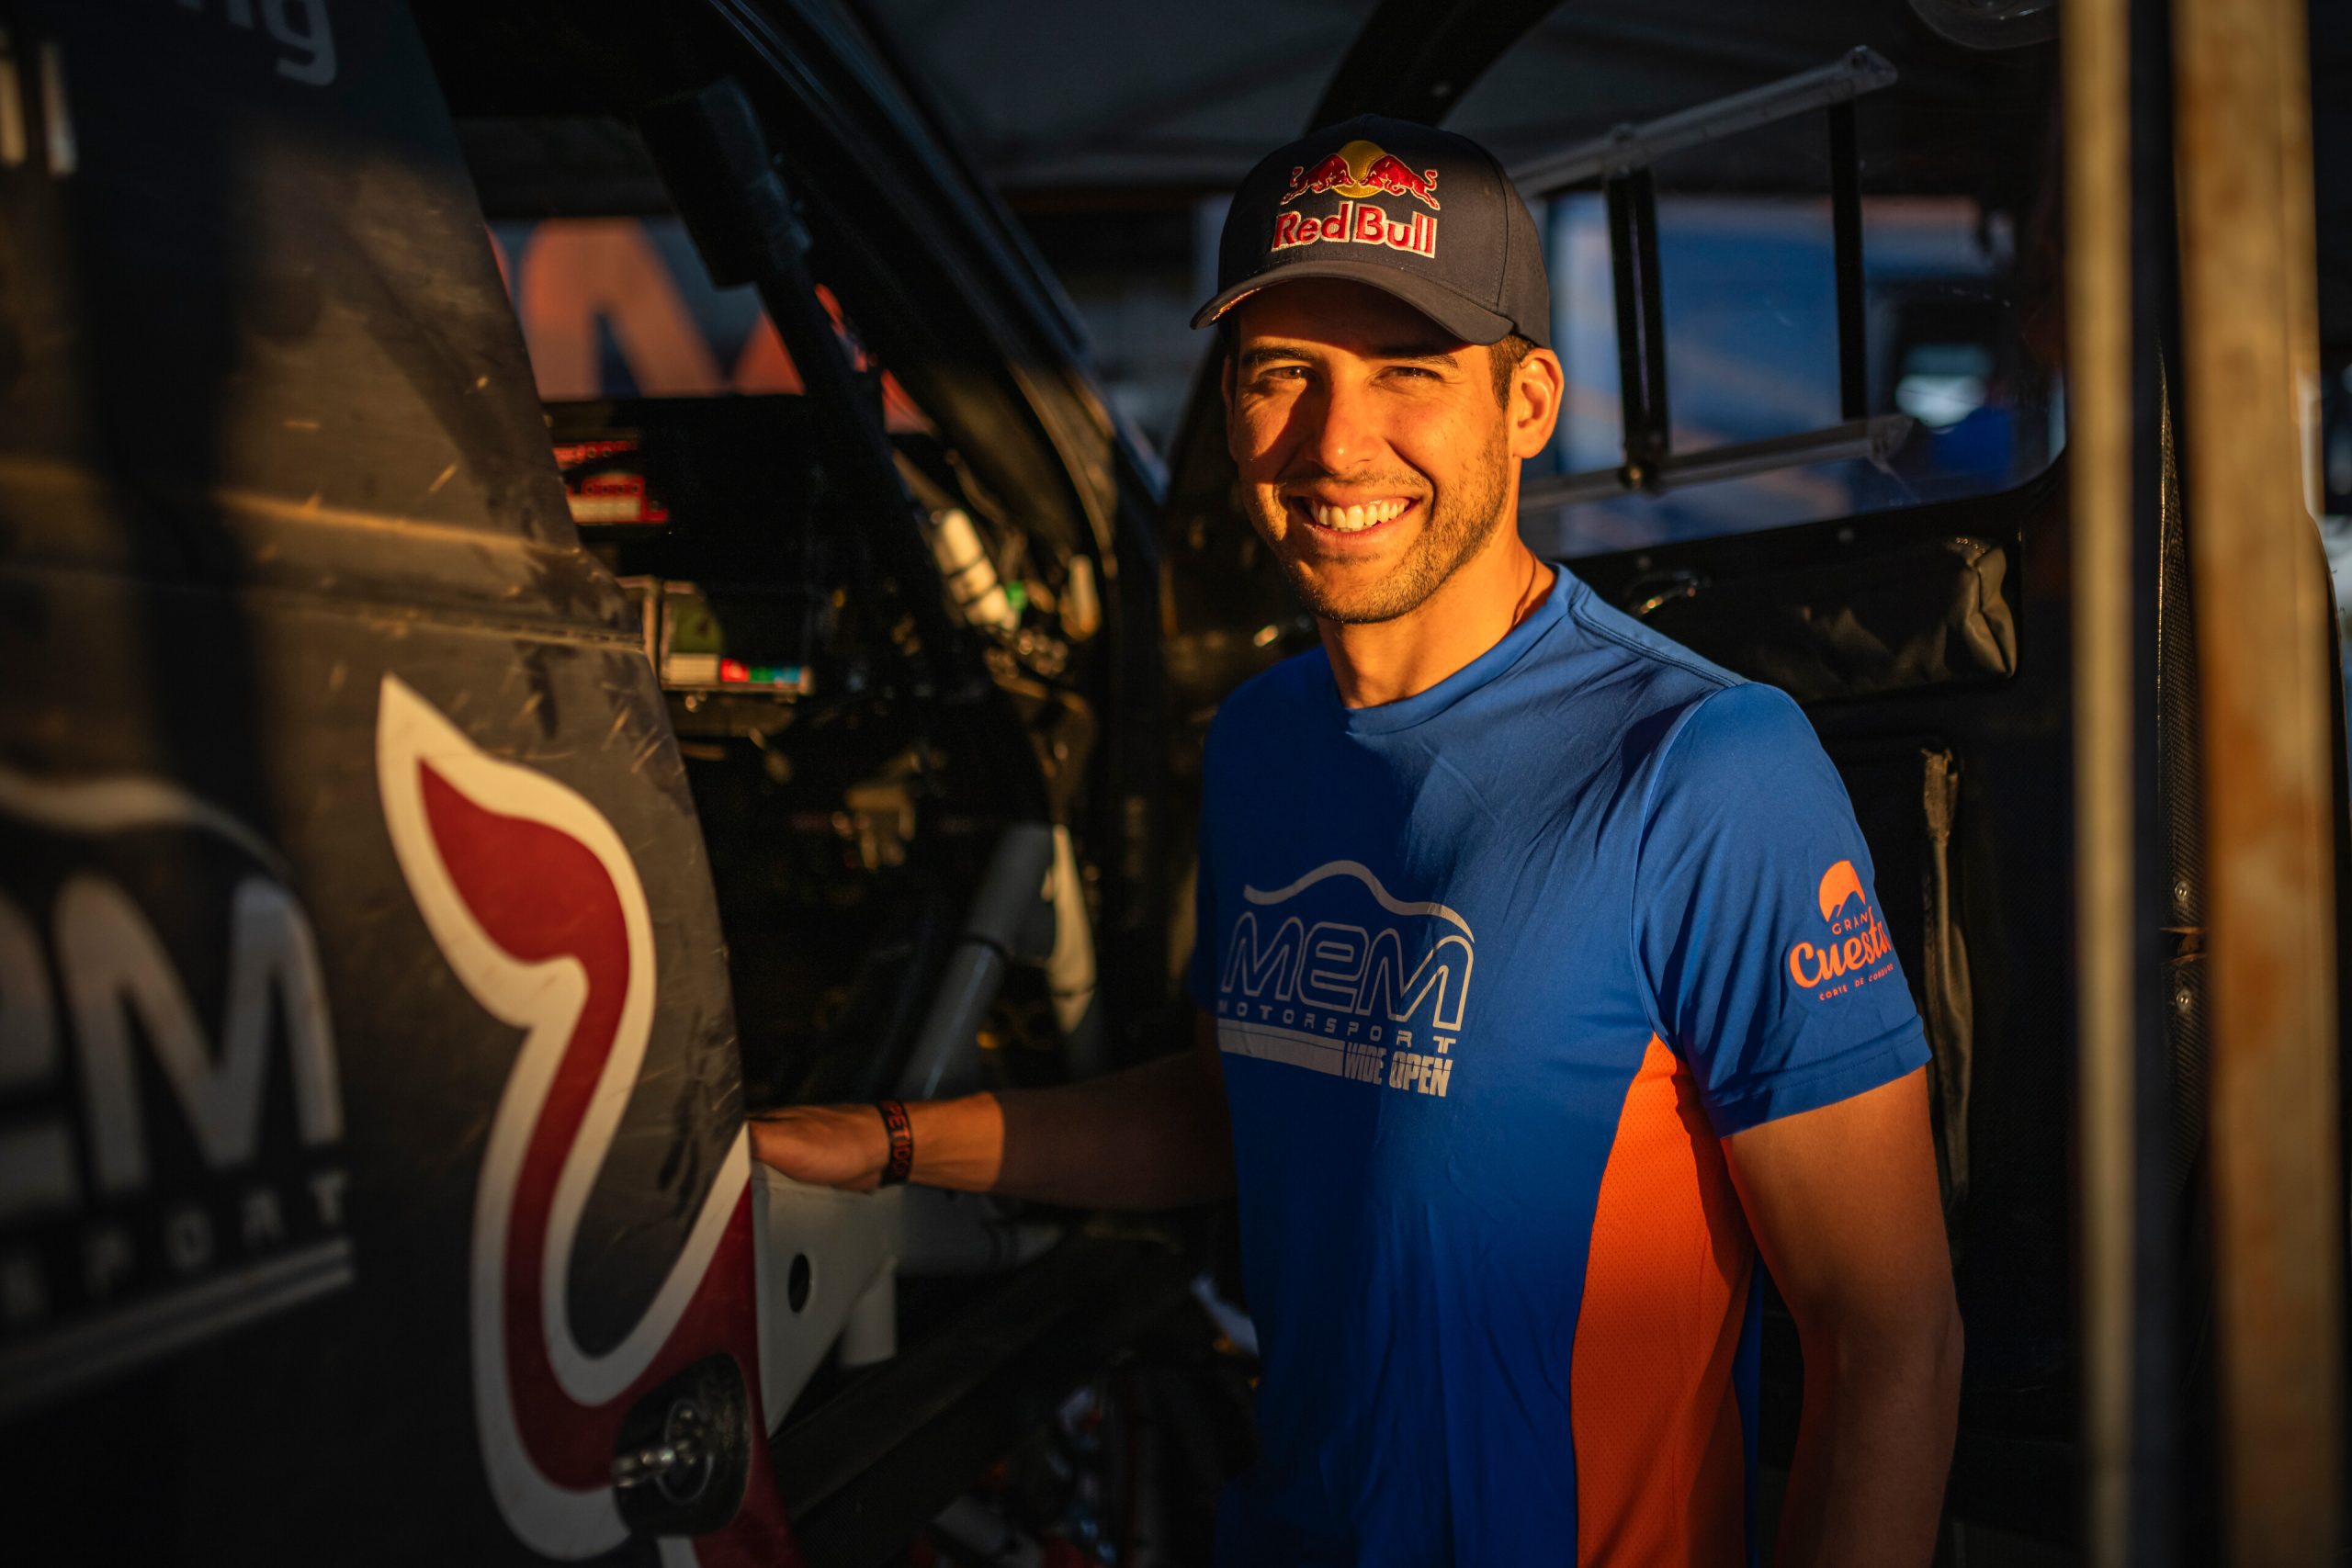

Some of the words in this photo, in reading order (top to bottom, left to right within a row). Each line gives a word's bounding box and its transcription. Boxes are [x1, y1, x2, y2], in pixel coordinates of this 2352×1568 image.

[1272, 200, 1353, 252] Red
[1352, 203, 1438, 259] Bull
[1789, 905, 1893, 988] Cuesta
[1832, 911, 1869, 935] GRAN
[1854, 977, 1864, 987] DE
[1217, 998, 1457, 1055] MOTORSPORT
[1388, 1051, 1453, 1098] OPEN
